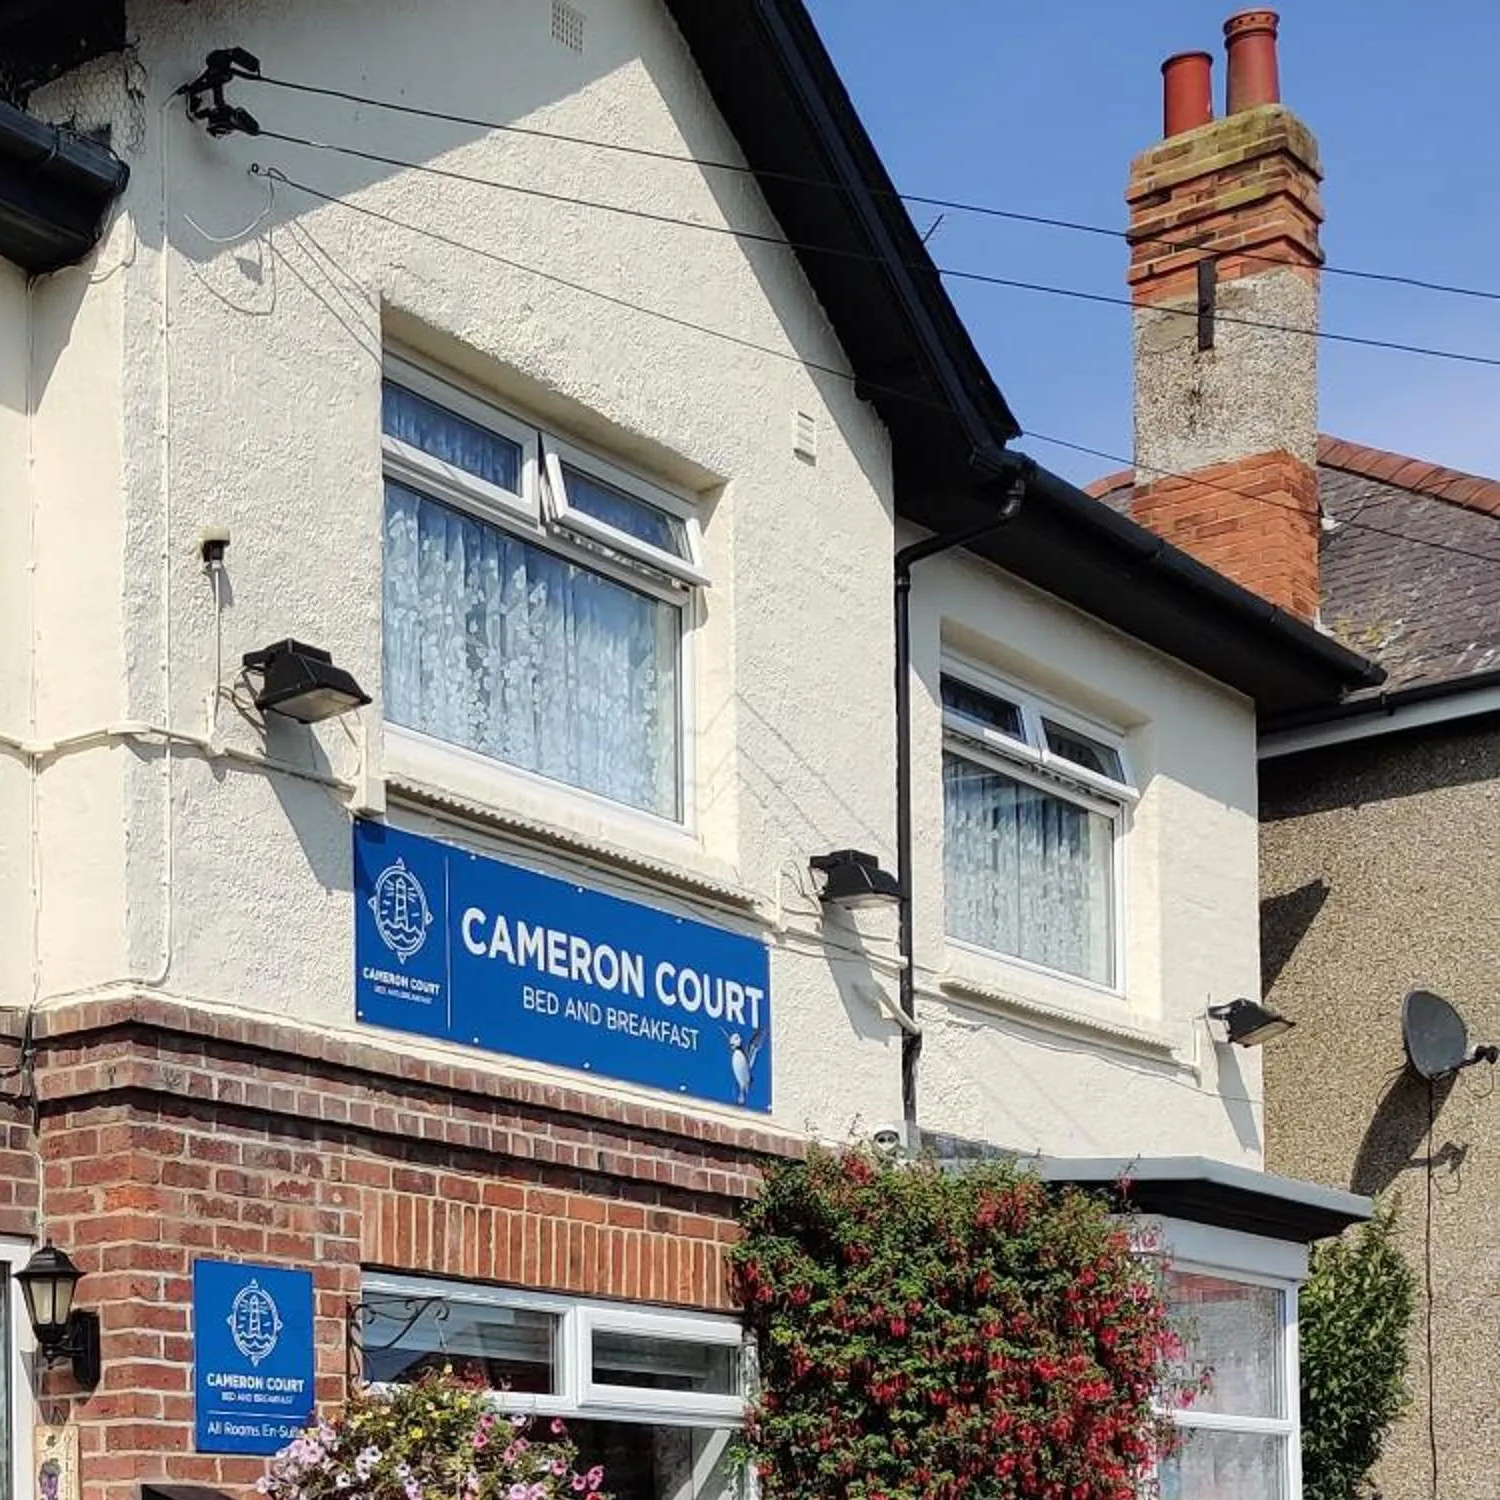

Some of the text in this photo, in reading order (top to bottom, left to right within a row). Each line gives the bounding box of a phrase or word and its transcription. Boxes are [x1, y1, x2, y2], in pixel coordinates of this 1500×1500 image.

[363, 967, 409, 989] CAMERON
[461, 907, 764, 1029] CAMERON COURT
[522, 985, 700, 1051] BED AND BREAKFAST
[206, 1372, 305, 1393] CAMERON COURT
[207, 1419, 222, 1435] All
[223, 1421, 260, 1437] Rooms
